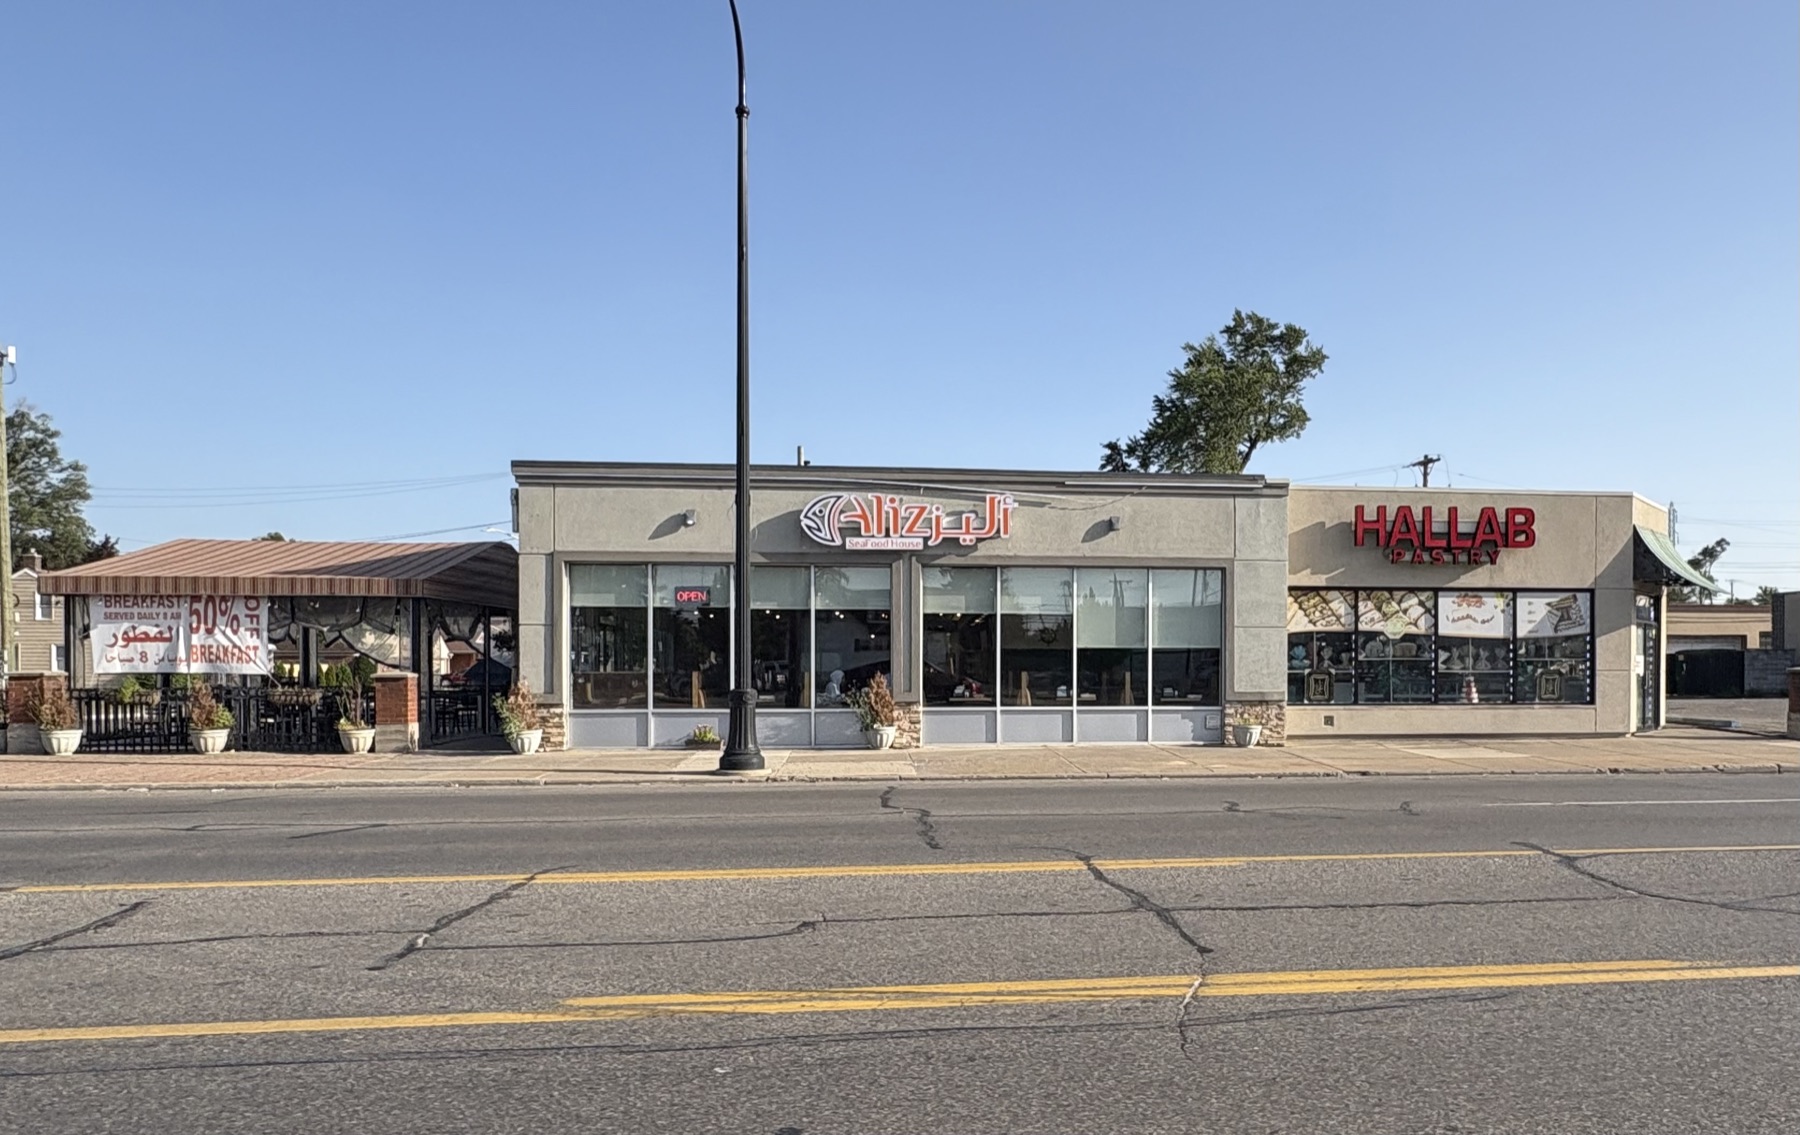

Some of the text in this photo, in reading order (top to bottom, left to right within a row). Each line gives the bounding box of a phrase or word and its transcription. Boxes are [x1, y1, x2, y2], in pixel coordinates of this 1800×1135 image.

[1354, 504, 1537, 549] HALLAB
[891, 538, 921, 548] House
[1390, 549, 1500, 565] PASTRY
[103, 595, 182, 608] BREAKFAST
[677, 591, 707, 602] OPEN
[103, 611, 135, 620] SERVED
[137, 611, 160, 620] DAILY
[189, 594, 240, 635] 50%
[244, 594, 261, 640] OFF
[139, 650, 149, 664] 8
[191, 644, 259, 664] BREAKFAST
